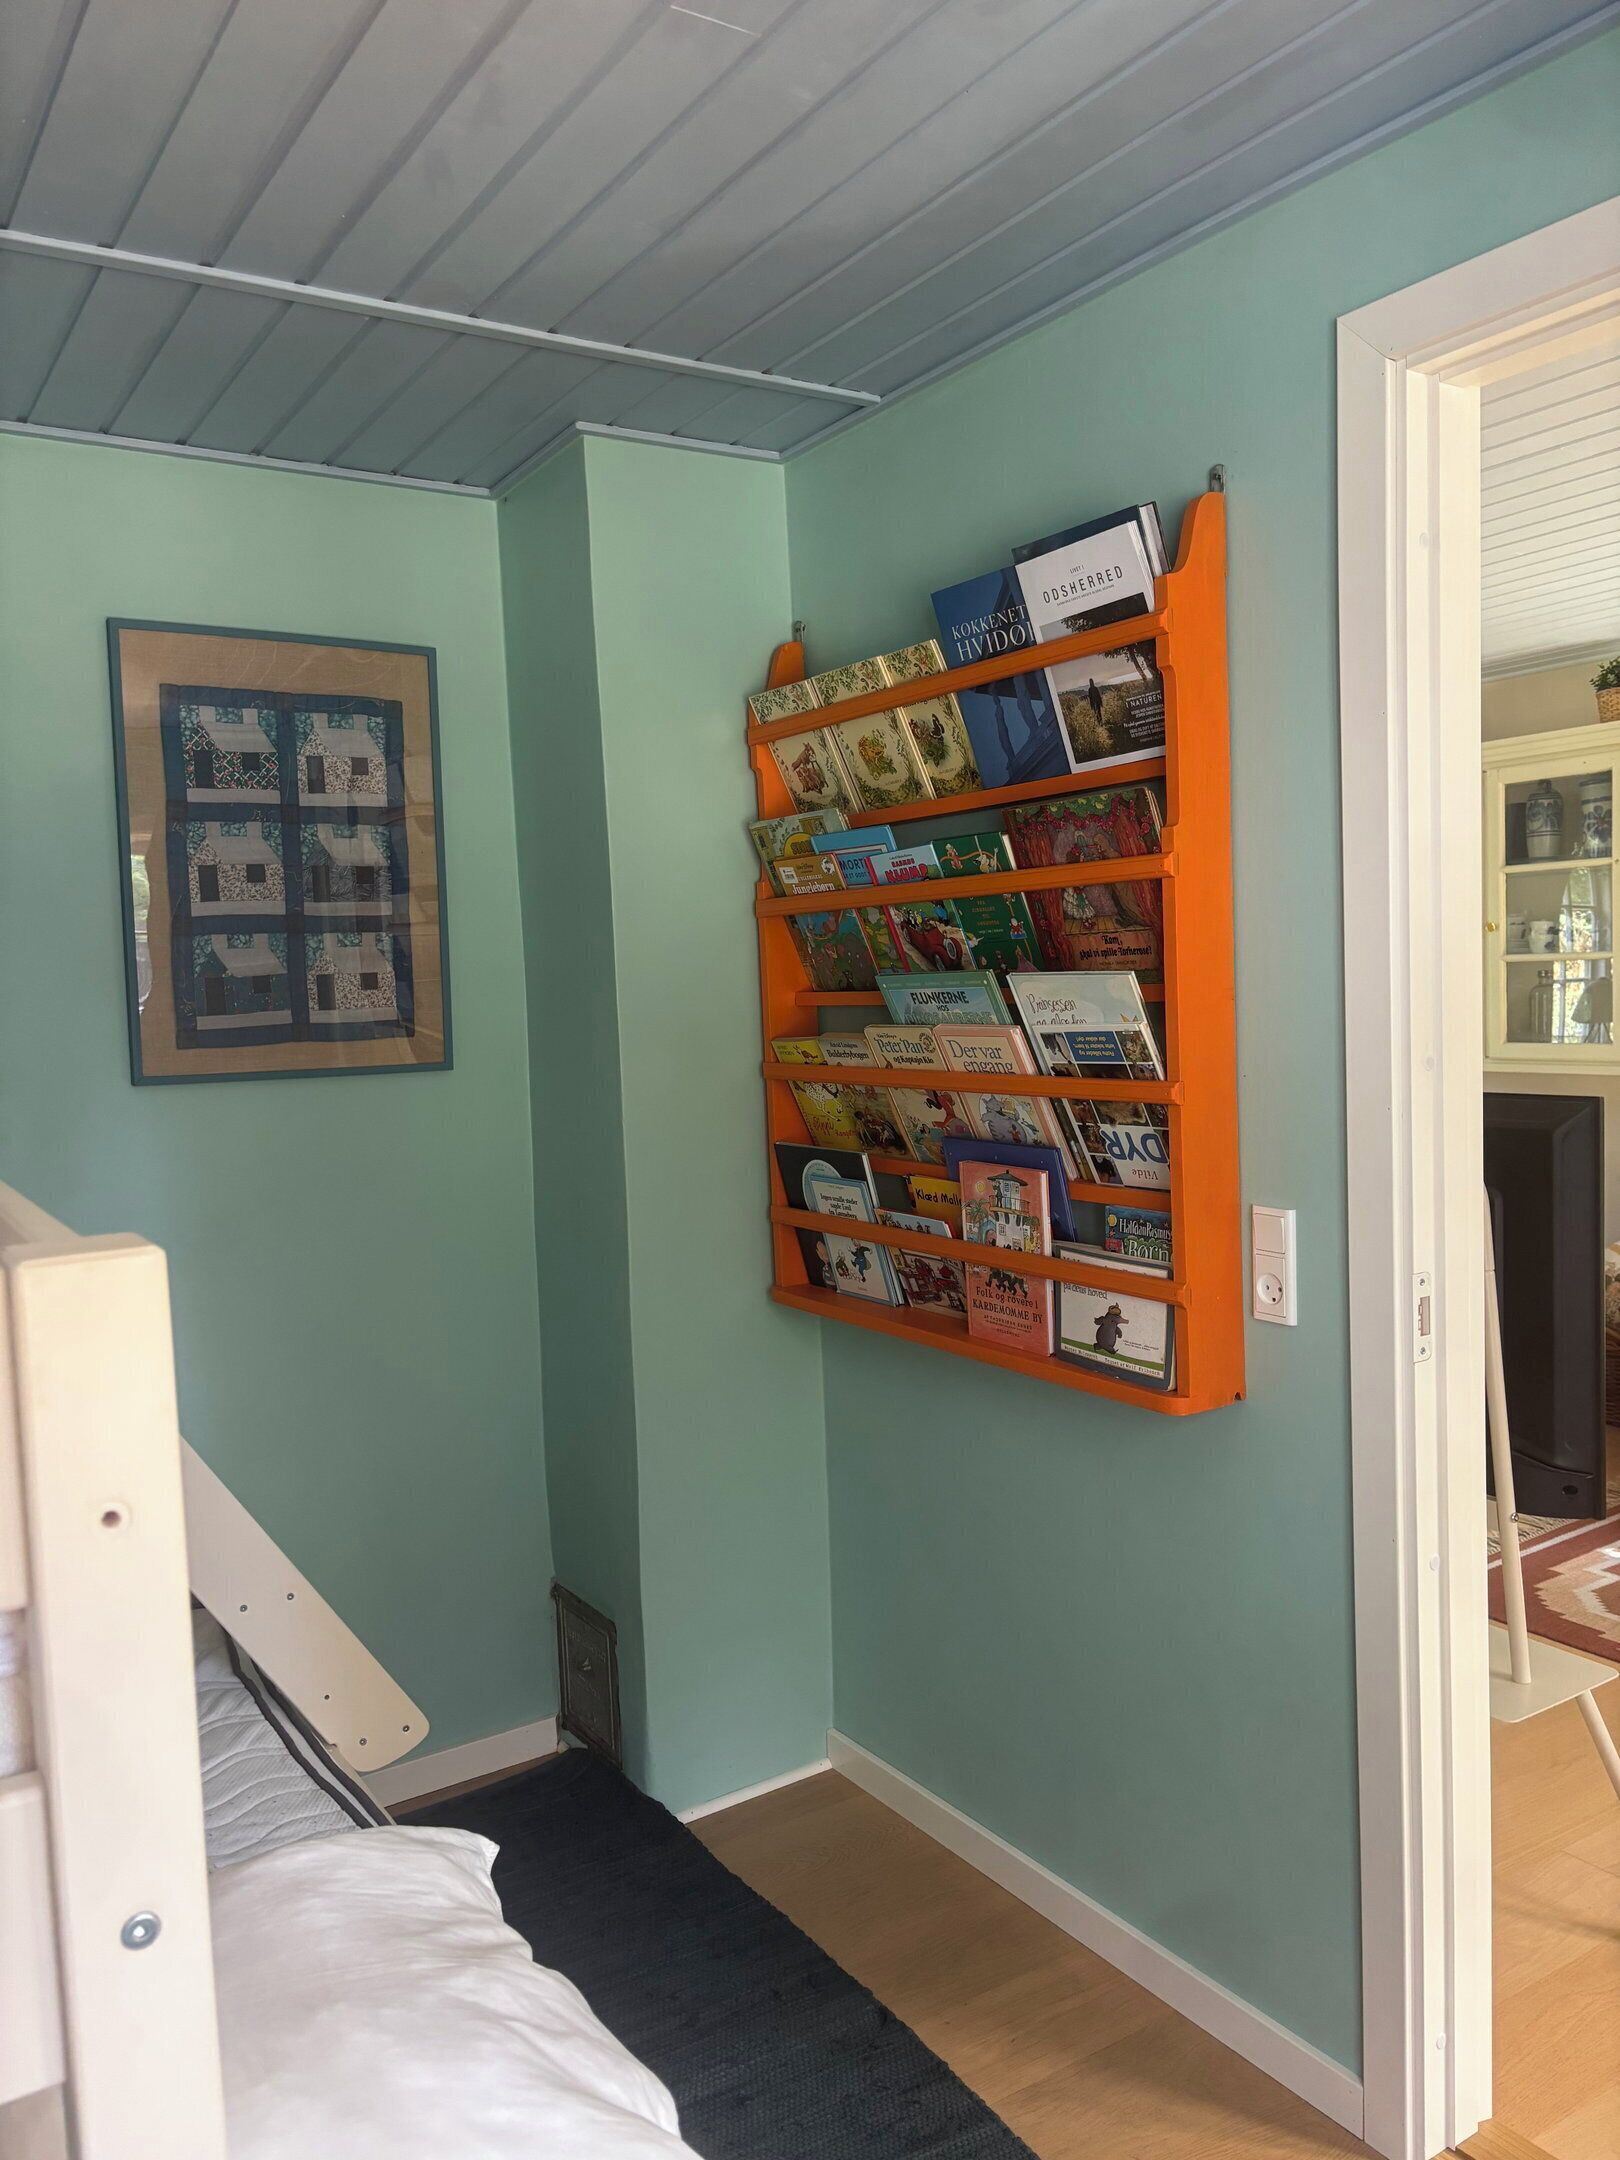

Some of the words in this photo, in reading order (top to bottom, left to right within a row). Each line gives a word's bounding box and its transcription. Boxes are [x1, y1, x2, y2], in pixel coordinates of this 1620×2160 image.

[1042, 565, 1124, 604] ODSHERRED
[884, 863, 929, 883] KLUMP
[910, 990, 970, 1005] FLUNKERNE
[1026, 993, 1078, 1014] Prinsessen
[876, 1039, 902, 1054] Peter
[902, 1038, 925, 1054] Pan
[947, 1040, 978, 1058] Der
[979, 1046, 1003, 1060] var
[964, 1061, 1014, 1074] engang
[1100, 1129, 1168, 1164] DYR
[1132, 1168, 1158, 1180] Vilde
[915, 1188, 938, 1202] Klæd
[1120, 1218, 1146, 1236] Halfdan
[976, 1286, 994, 1299] Folk
[996, 1293, 1005, 1304] og
[972, 1298, 1030, 1321] KARDEMOMME
[1033, 1312, 1043, 1324] BY
